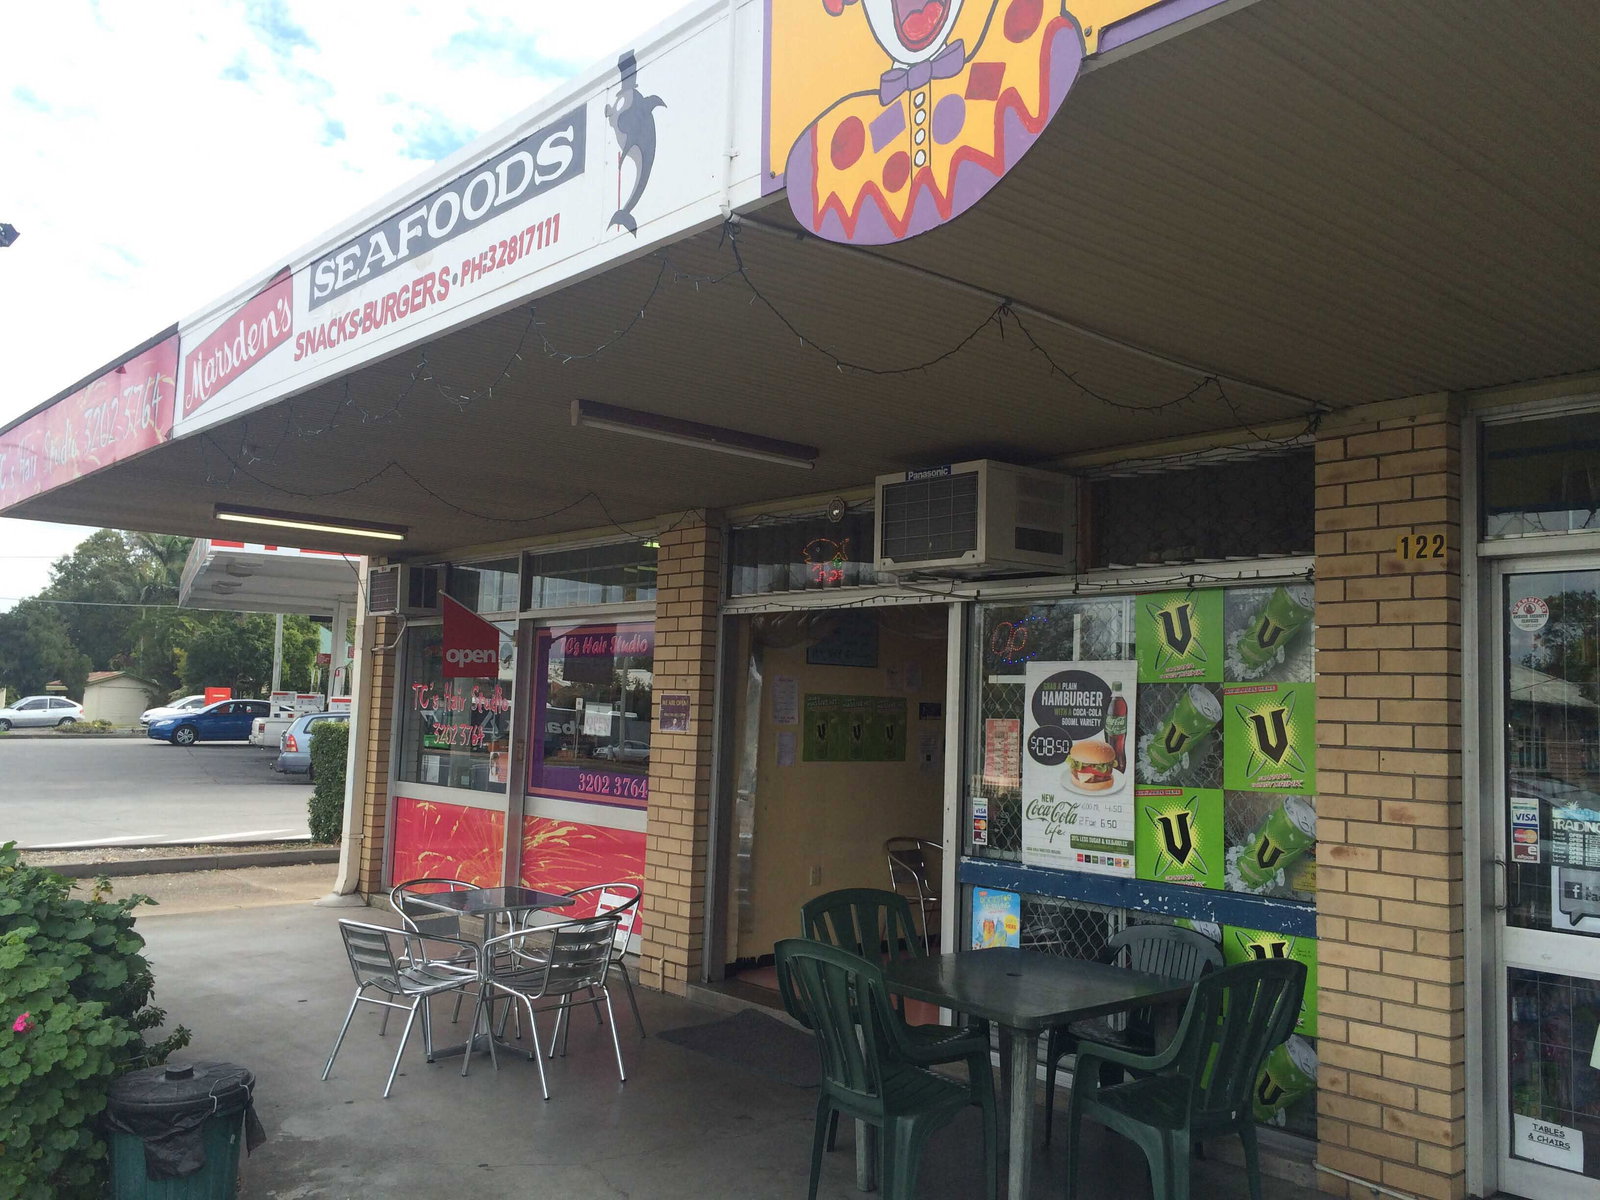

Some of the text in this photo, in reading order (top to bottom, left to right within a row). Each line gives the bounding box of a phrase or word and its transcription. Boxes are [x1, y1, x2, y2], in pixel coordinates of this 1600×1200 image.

[313, 125, 574, 300] SEAFOODS
[185, 295, 292, 410] Marsden's
[907, 465, 950, 481] Panasonic
[1400, 534, 1446, 560] 122
[1511, 596, 1549, 615] WARNING
[610, 632, 649, 655] Studio
[445, 647, 498, 669] open
[1061, 682, 1078, 691] PLAIN
[411, 681, 510, 715] TC's Hair Studio
[1041, 690, 1104, 707] HAMBURGER
[1072, 708, 1103, 717] COCA-COLA
[1079, 717, 1102, 728] VARIETY
[433, 721, 486, 749] 3202 3764
[577, 772, 649, 799] 3202 3764
[1041, 793, 1055, 803] NEW
[1515, 812, 1537, 822] VISA
[1044, 821, 1066, 844] life
[1532, 1122, 1566, 1138] TABLES
[1528, 1132, 1571, 1150] & CHAIRS
